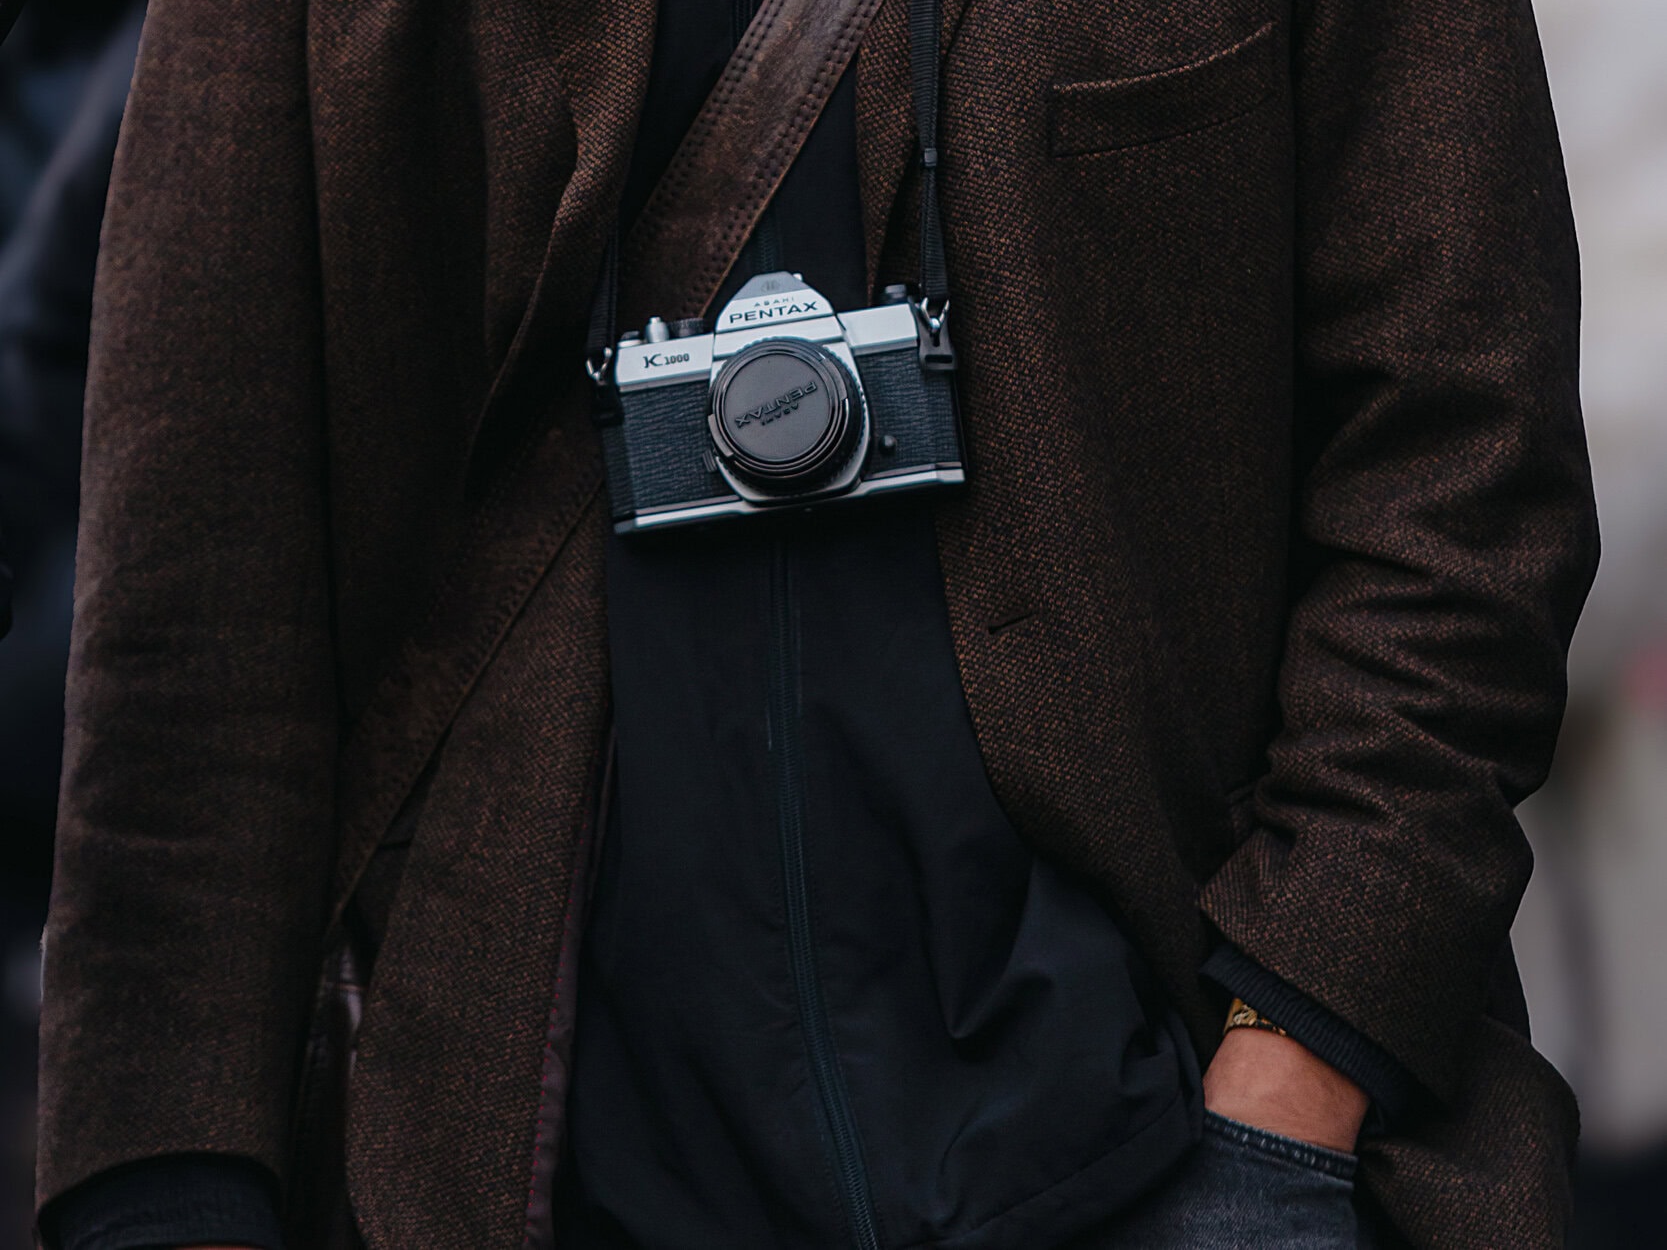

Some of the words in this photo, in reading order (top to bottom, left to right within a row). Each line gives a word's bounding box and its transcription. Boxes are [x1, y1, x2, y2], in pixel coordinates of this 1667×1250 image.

[729, 300, 818, 324] PENTAX
[754, 296, 795, 308] ASAHI
[735, 381, 818, 428] PENTAX
